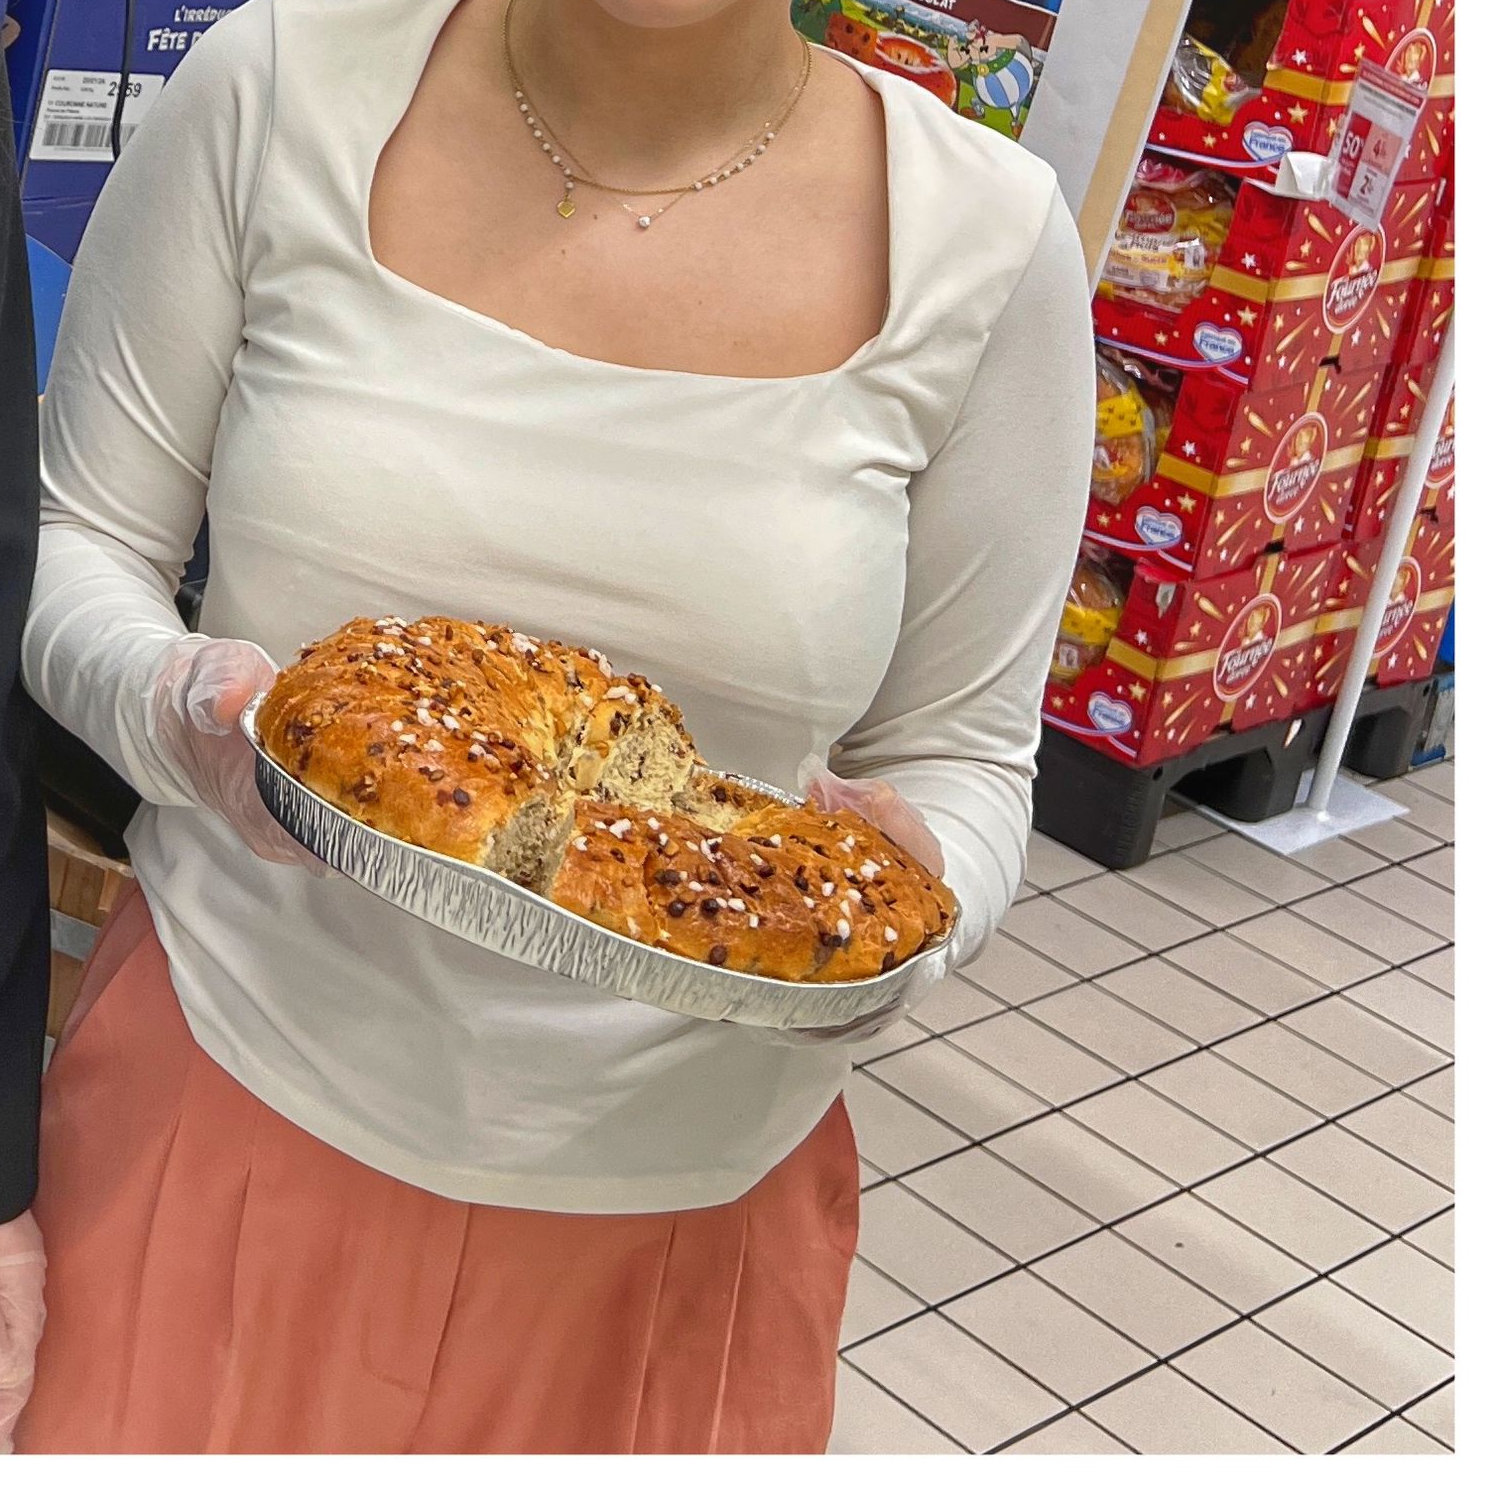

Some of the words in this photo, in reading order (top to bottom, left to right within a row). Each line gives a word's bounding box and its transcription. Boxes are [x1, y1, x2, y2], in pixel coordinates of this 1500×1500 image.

[147, 28, 188, 51] FÊTE
[107, 82, 142, 98] 259
[1252, 137, 1286, 152] France
